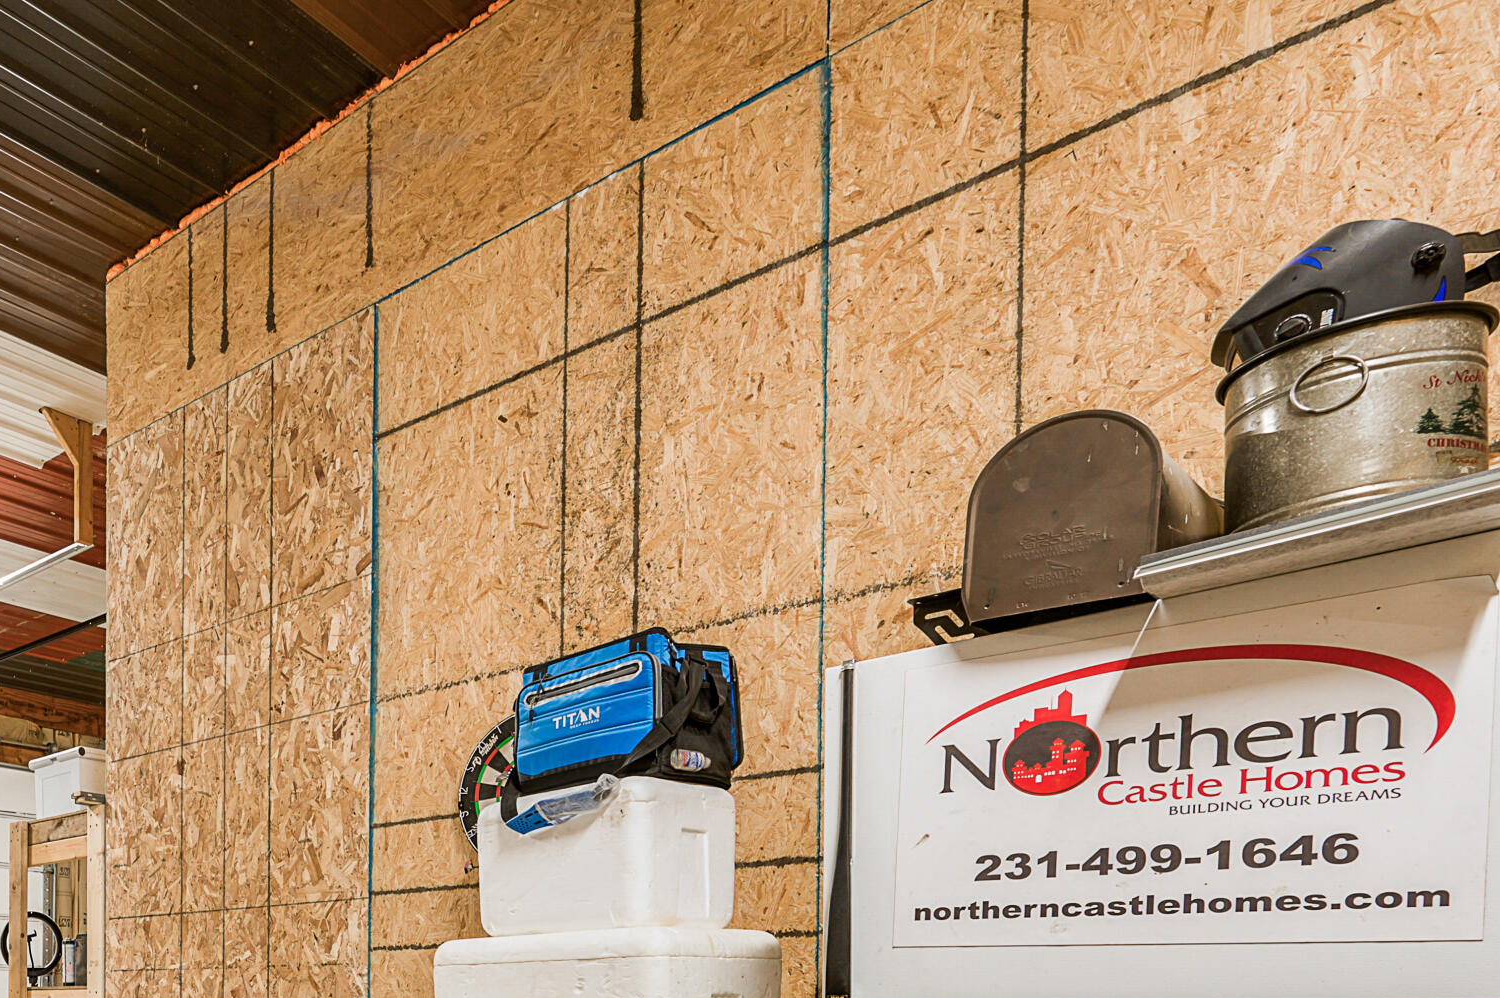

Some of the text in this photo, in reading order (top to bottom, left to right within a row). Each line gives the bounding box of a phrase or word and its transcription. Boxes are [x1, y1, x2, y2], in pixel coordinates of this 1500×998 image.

[552, 705, 600, 729] TITAN
[940, 707, 1405, 795] Northern
[1098, 761, 1406, 806] Castle Homes
[1169, 787, 1402, 816] BUILDING YOUR DREAMS
[974, 832, 1360, 881] 231-499-1646
[914, 888, 1450, 922] northerncastlehomes.com
